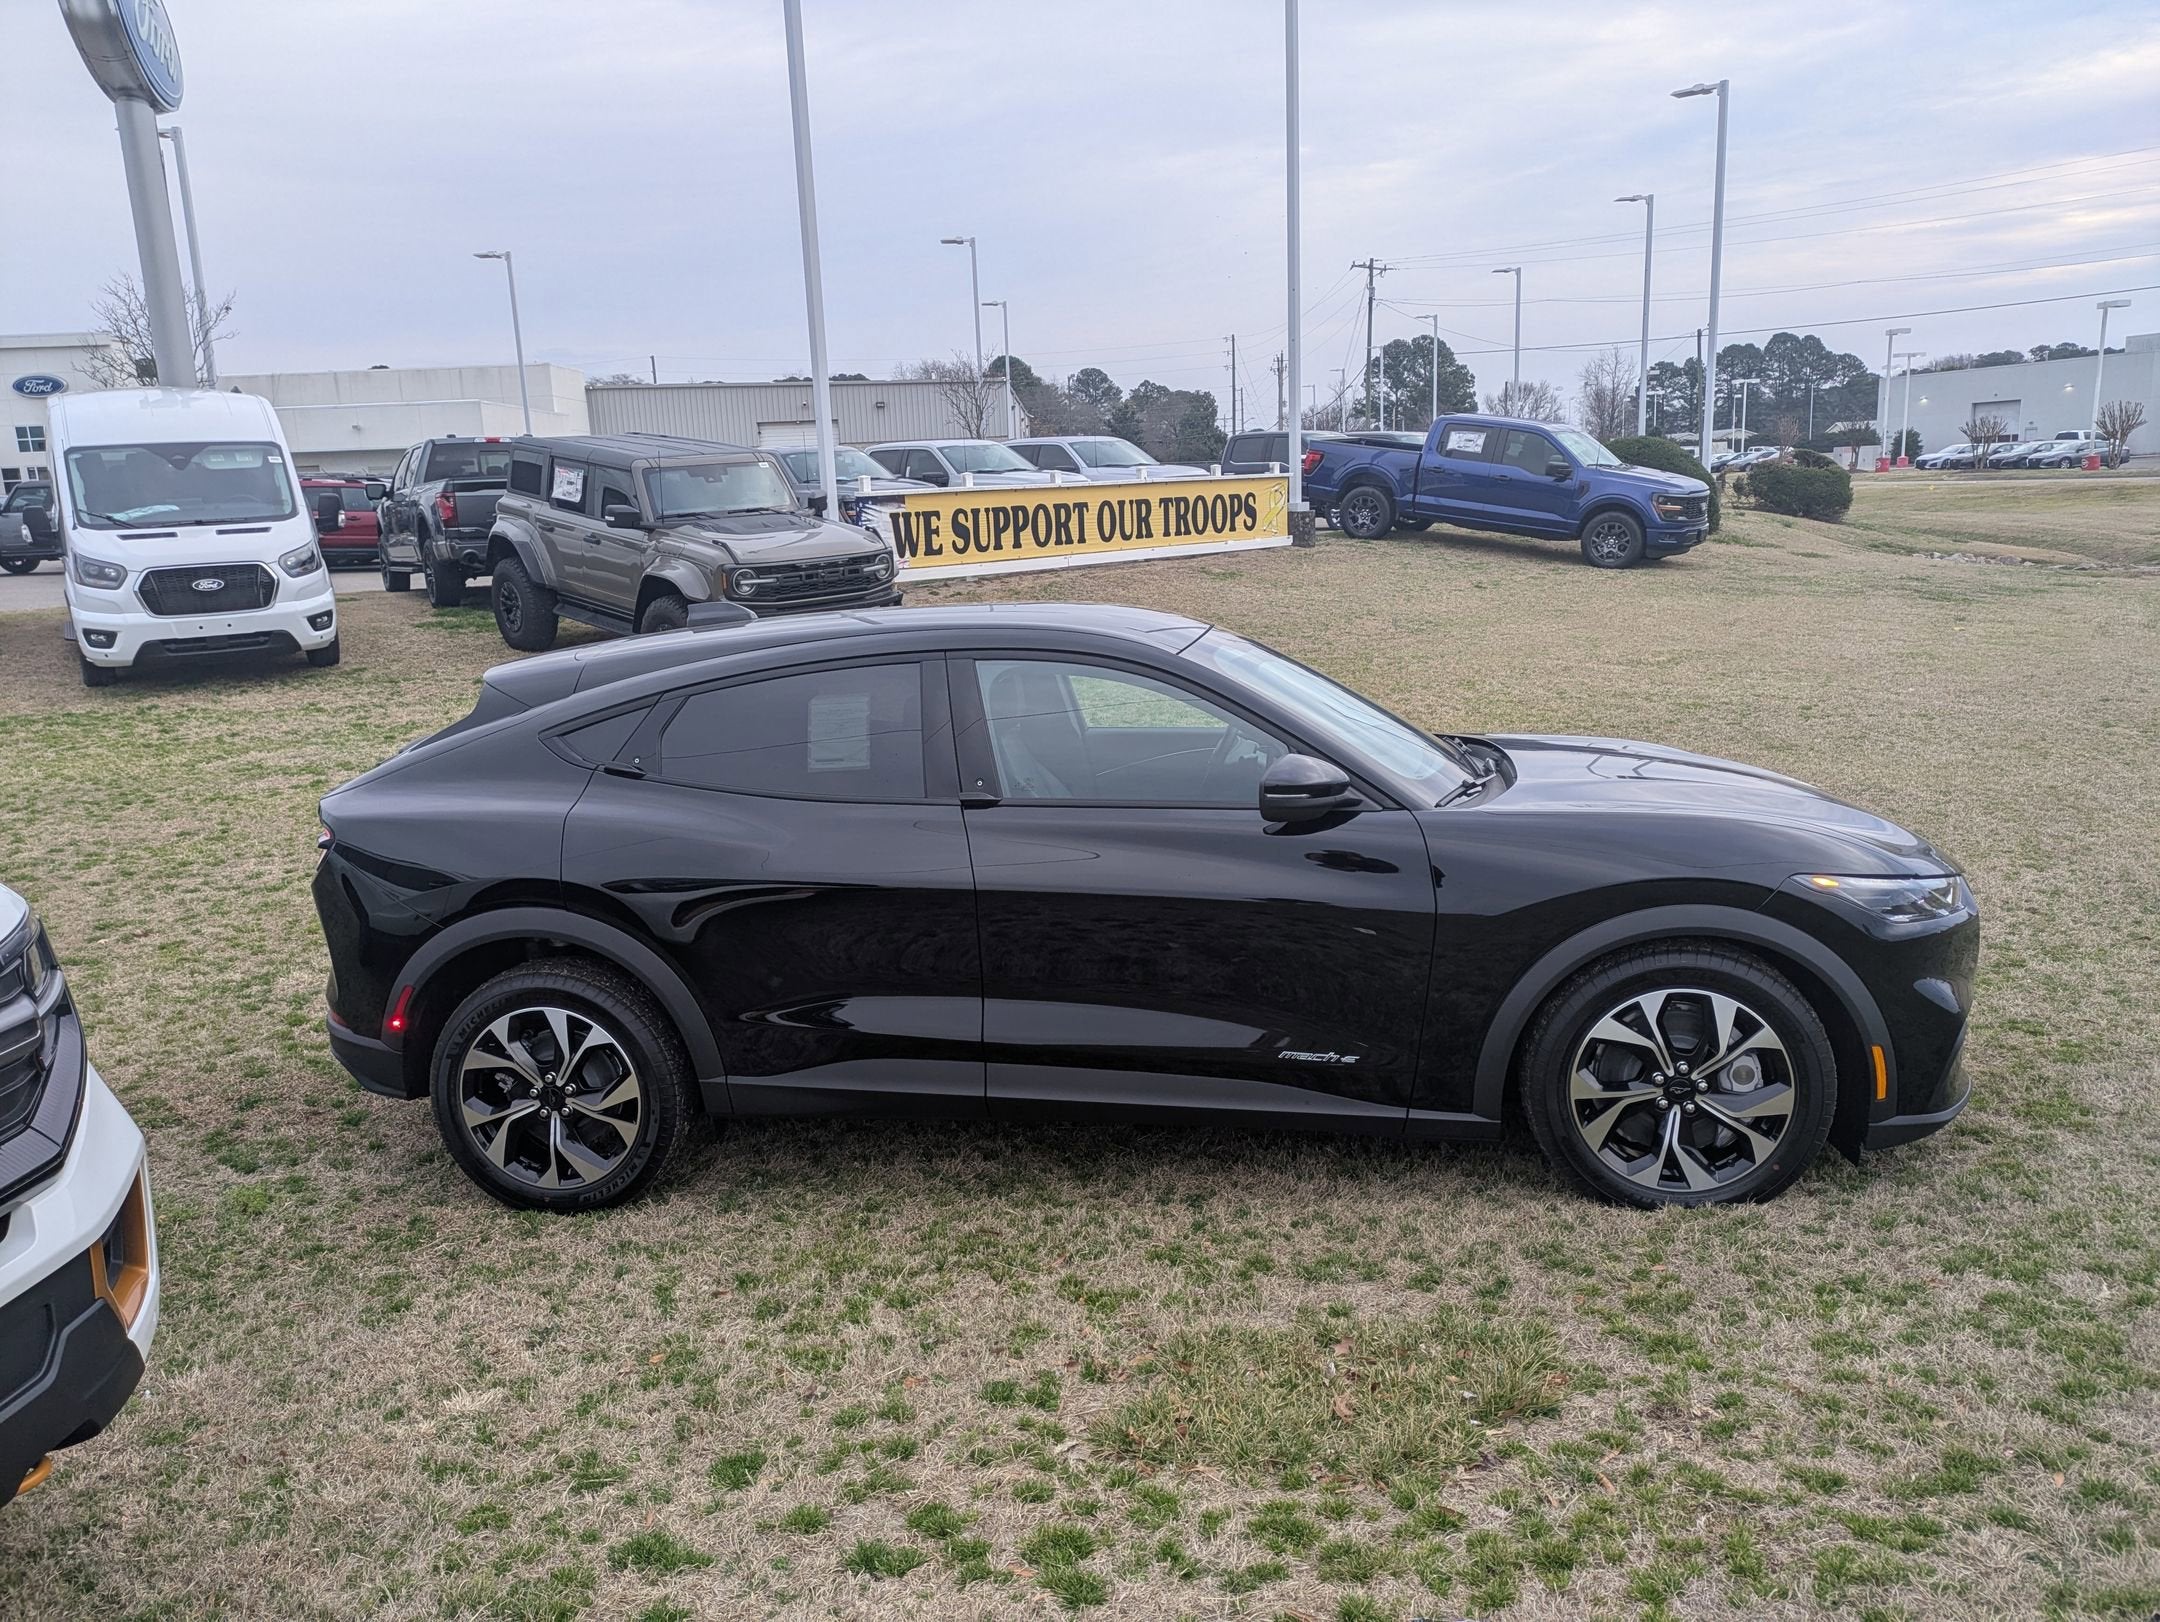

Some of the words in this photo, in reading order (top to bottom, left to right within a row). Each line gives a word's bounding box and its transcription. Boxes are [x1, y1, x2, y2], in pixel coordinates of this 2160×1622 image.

[24, 380, 53, 392] Ford
[889, 510, 944, 559] WE
[951, 501, 1090, 555] SUPPORT
[1097, 498, 1154, 542] OUR
[1159, 492, 1257, 537] TROOPS
[583, 1162, 638, 1201] MICHELIN
